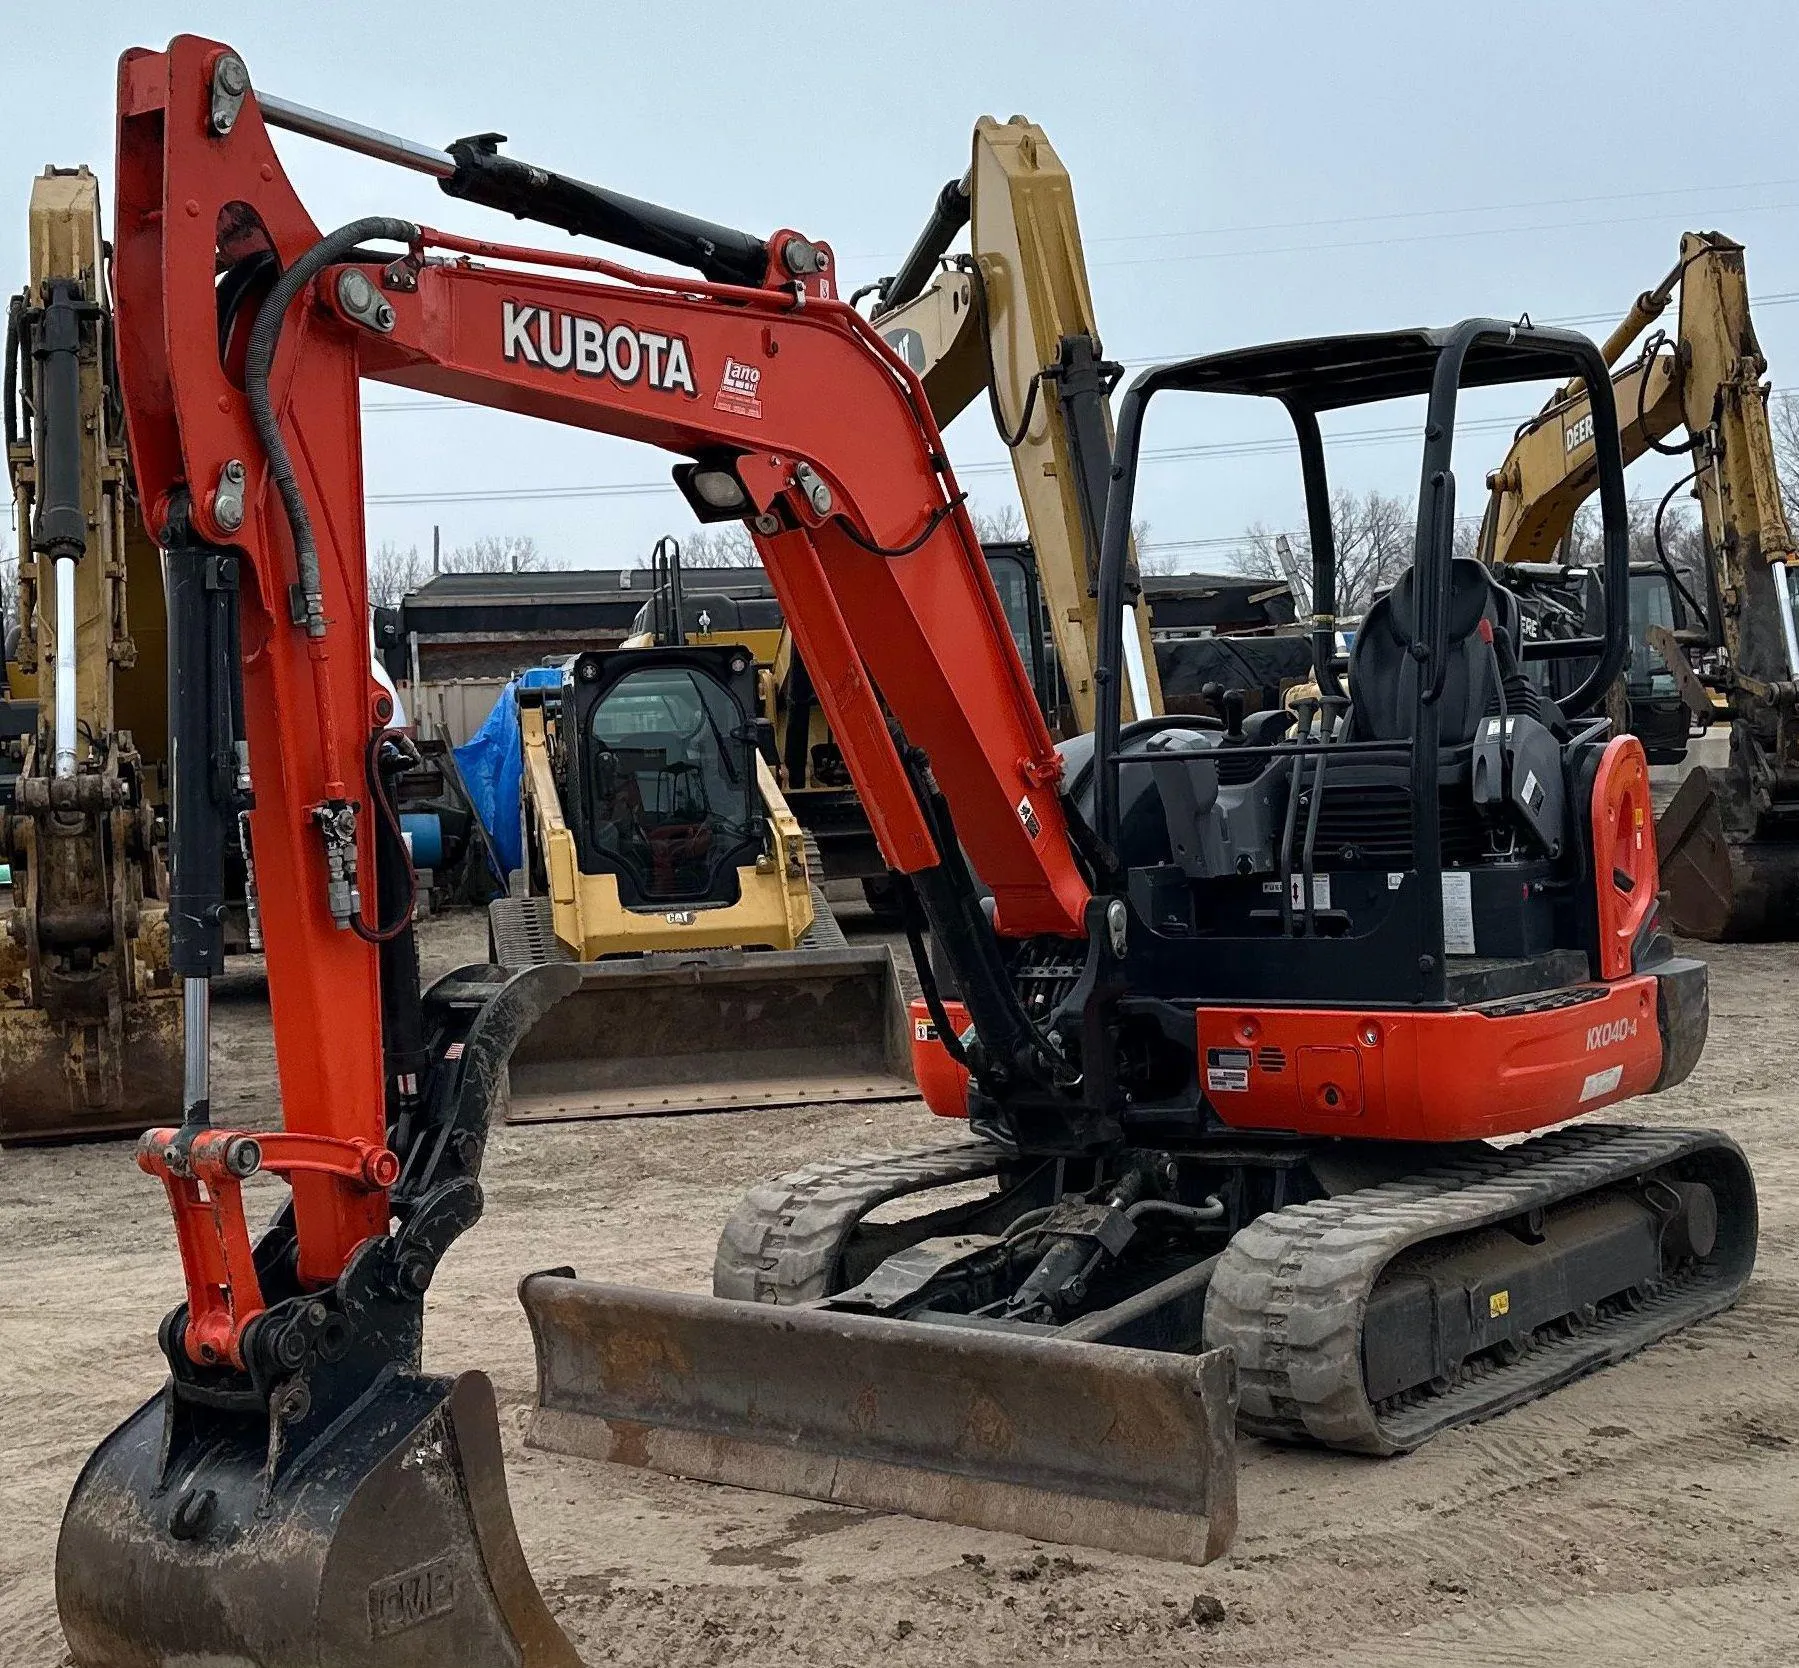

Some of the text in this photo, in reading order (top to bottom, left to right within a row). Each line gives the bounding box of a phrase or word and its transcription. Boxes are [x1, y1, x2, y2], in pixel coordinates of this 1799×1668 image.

[502, 301, 695, 393] KUBOTA
[723, 357, 761, 384] Lano
[1566, 413, 1595, 452] DEER
[1520, 615, 1538, 638] ERE
[666, 911, 690, 923] CAT
[1585, 1017, 1639, 1052] KX040-4
